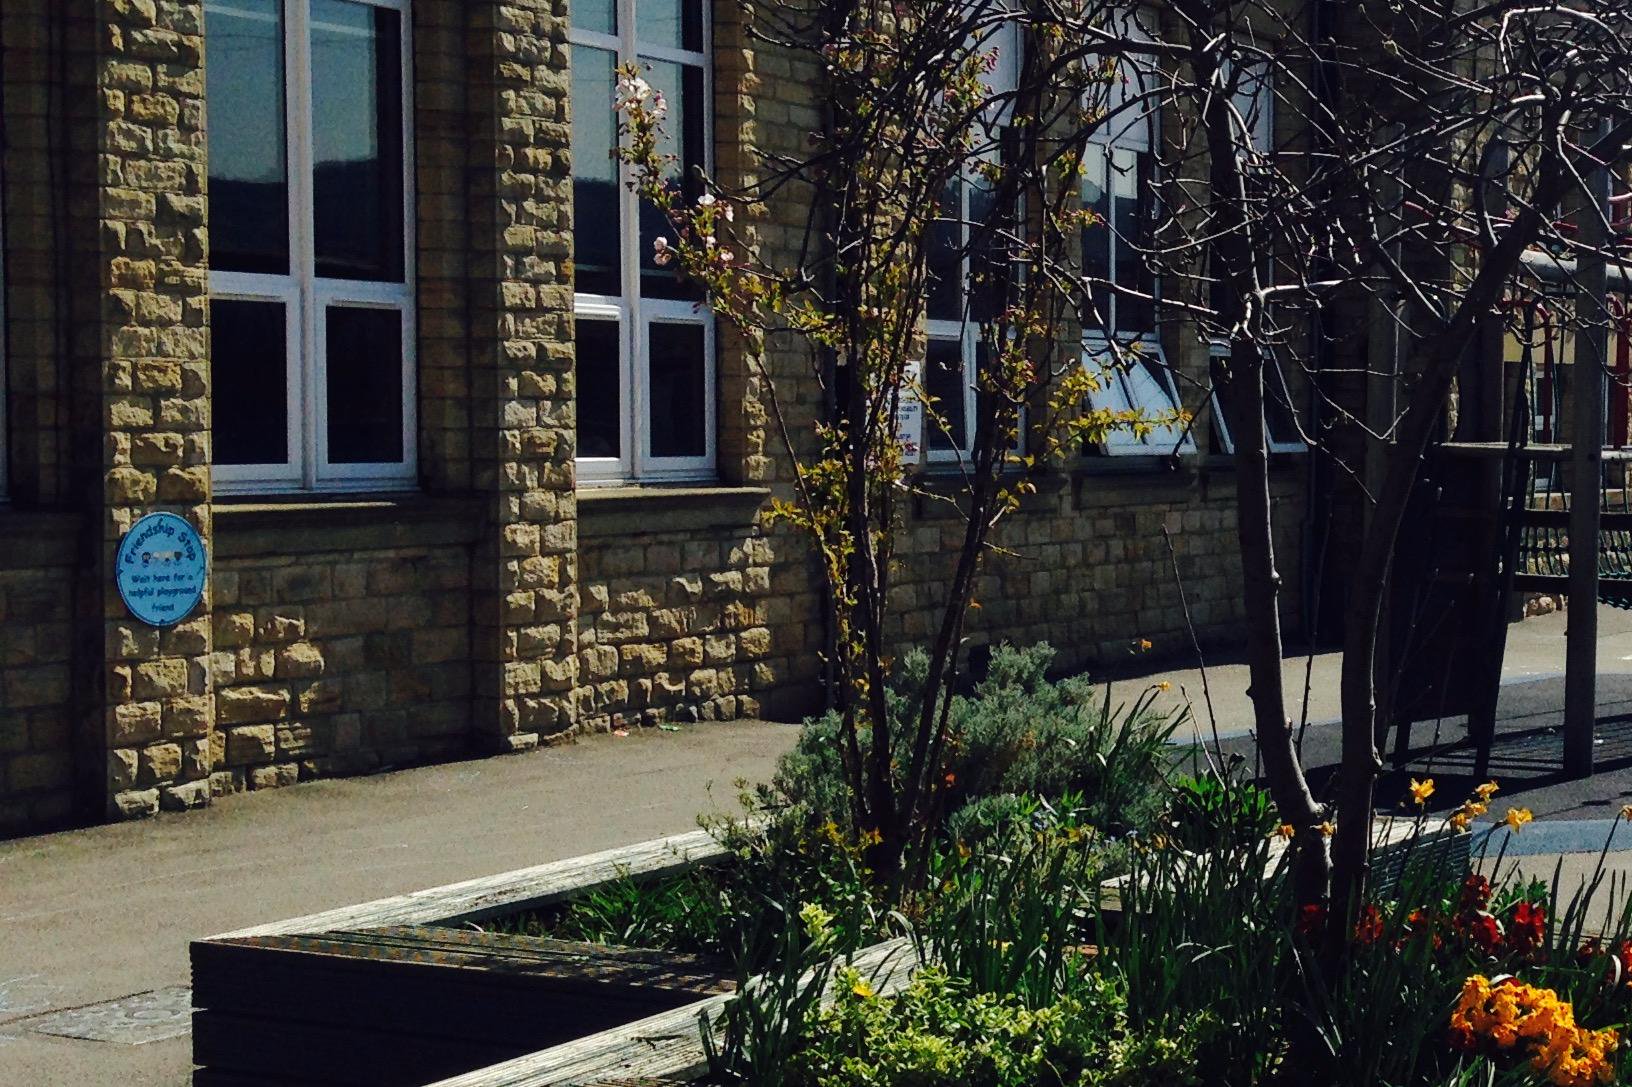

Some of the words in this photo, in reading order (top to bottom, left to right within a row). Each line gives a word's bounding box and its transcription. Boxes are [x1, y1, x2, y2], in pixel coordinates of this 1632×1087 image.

[125, 517, 174, 563] Friendship
[178, 532, 196, 561] Stop
[174, 573, 185, 581] for
